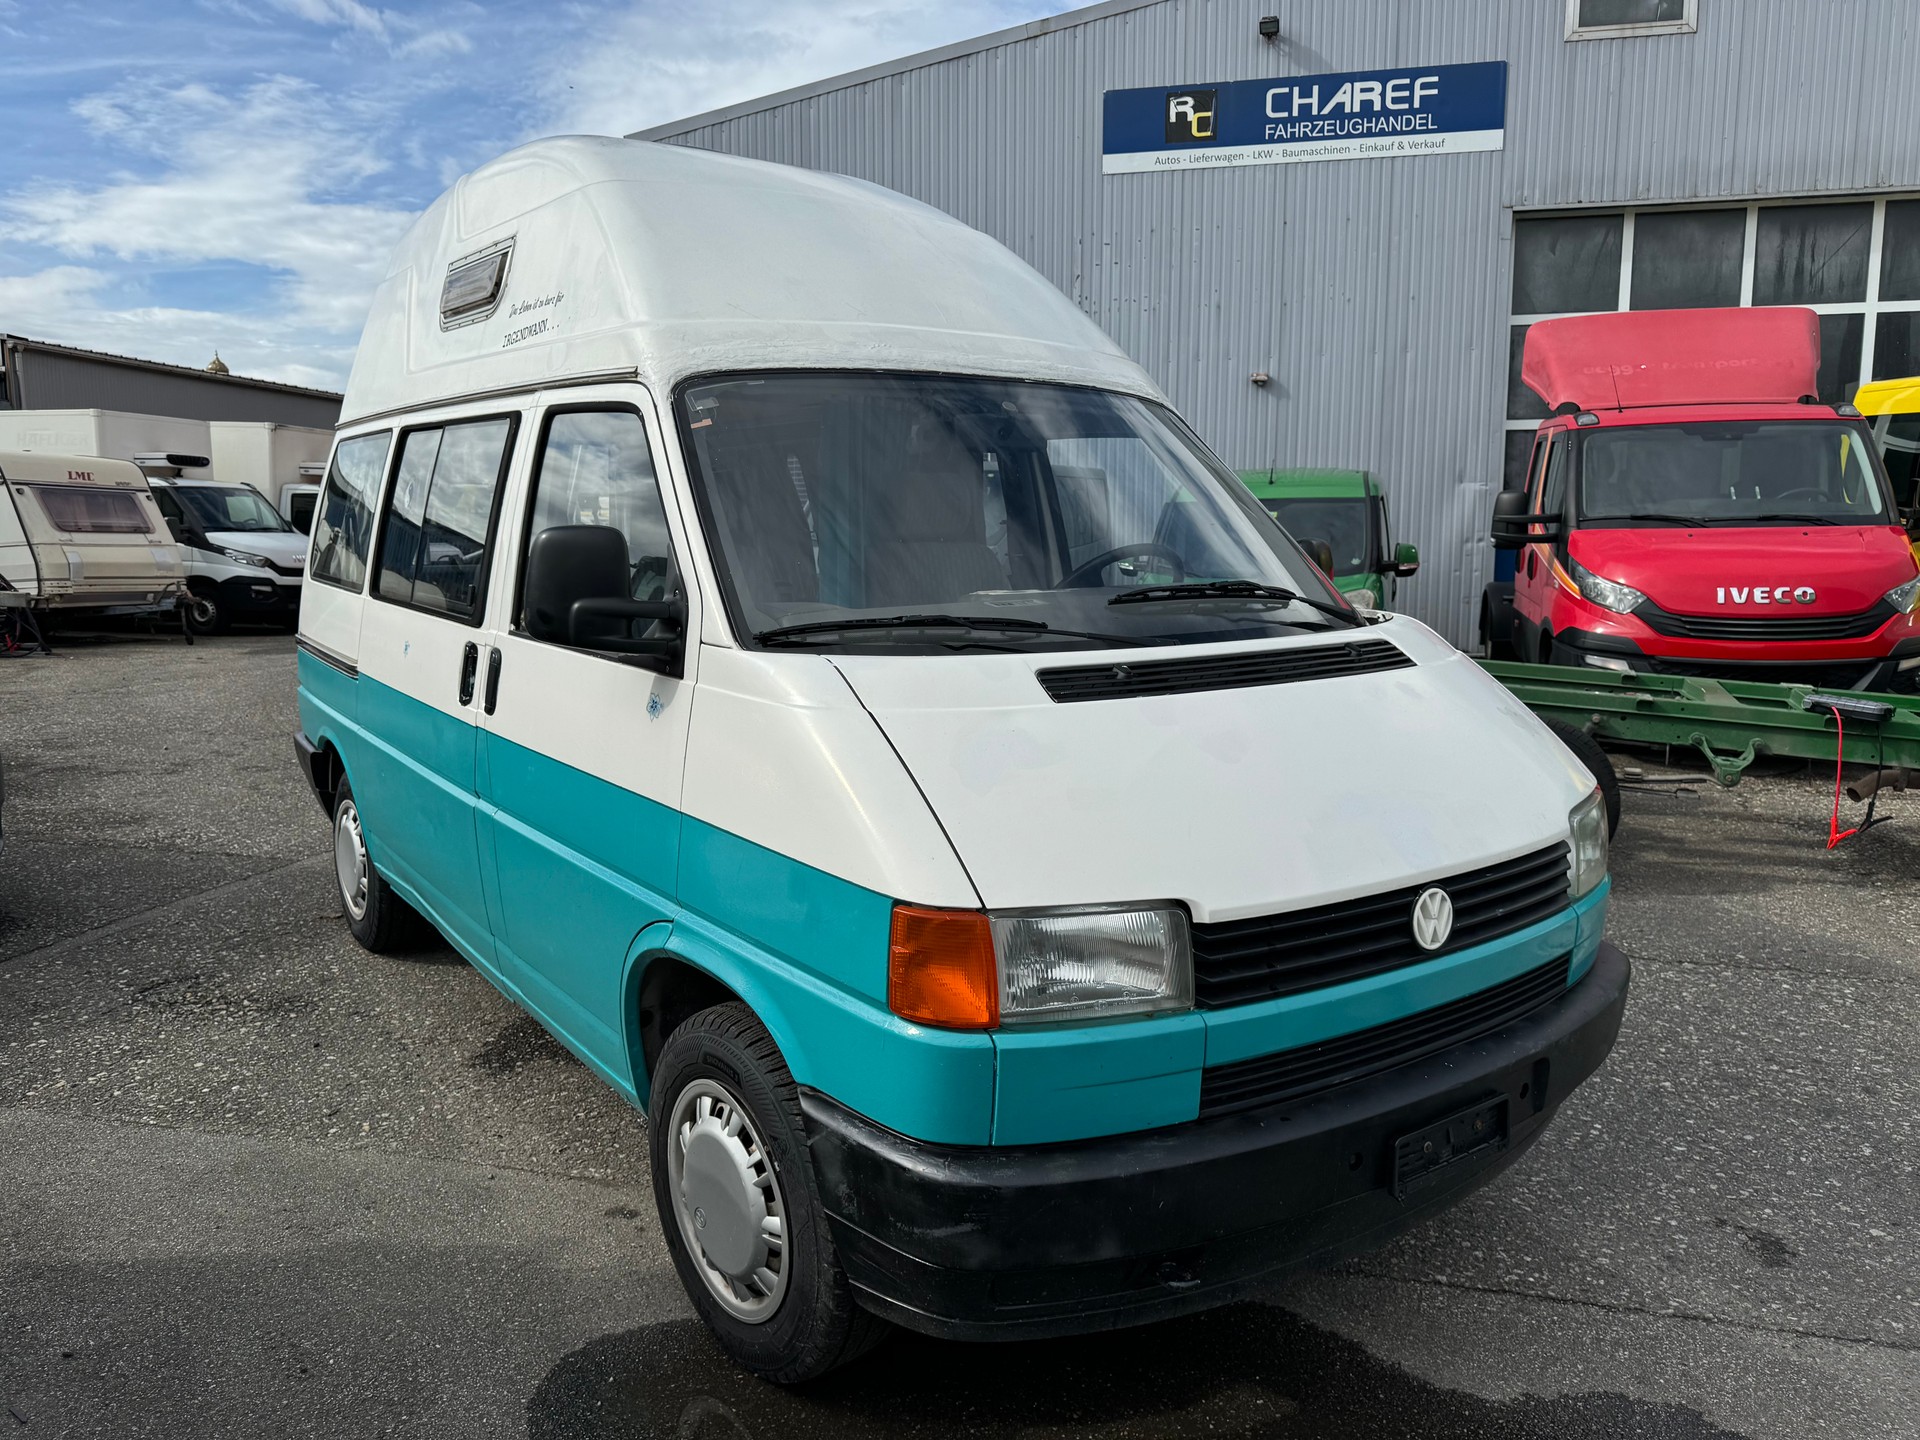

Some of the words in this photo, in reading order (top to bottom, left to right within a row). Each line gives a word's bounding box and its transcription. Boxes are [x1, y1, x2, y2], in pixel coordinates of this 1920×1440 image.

[1265, 76, 1439, 118] CHAREF
[1169, 96, 1214, 137] RC
[1265, 113, 1438, 140] FAHRZEUGHANDEL
[1154, 156, 1181, 165] Autos
[1188, 152, 1244, 164] Lieferwagen
[1252, 150, 1274, 160] LKW
[1282, 145, 1350, 158] Baumaschinen
[1359, 141, 1395, 153] Einkauf
[1397, 141, 1405, 150] &
[1408, 138, 1446, 150] Verkauf
[67, 470, 95, 481] LMC
[1716, 587, 1816, 604] IVECO
[1413, 888, 1453, 950] VW
